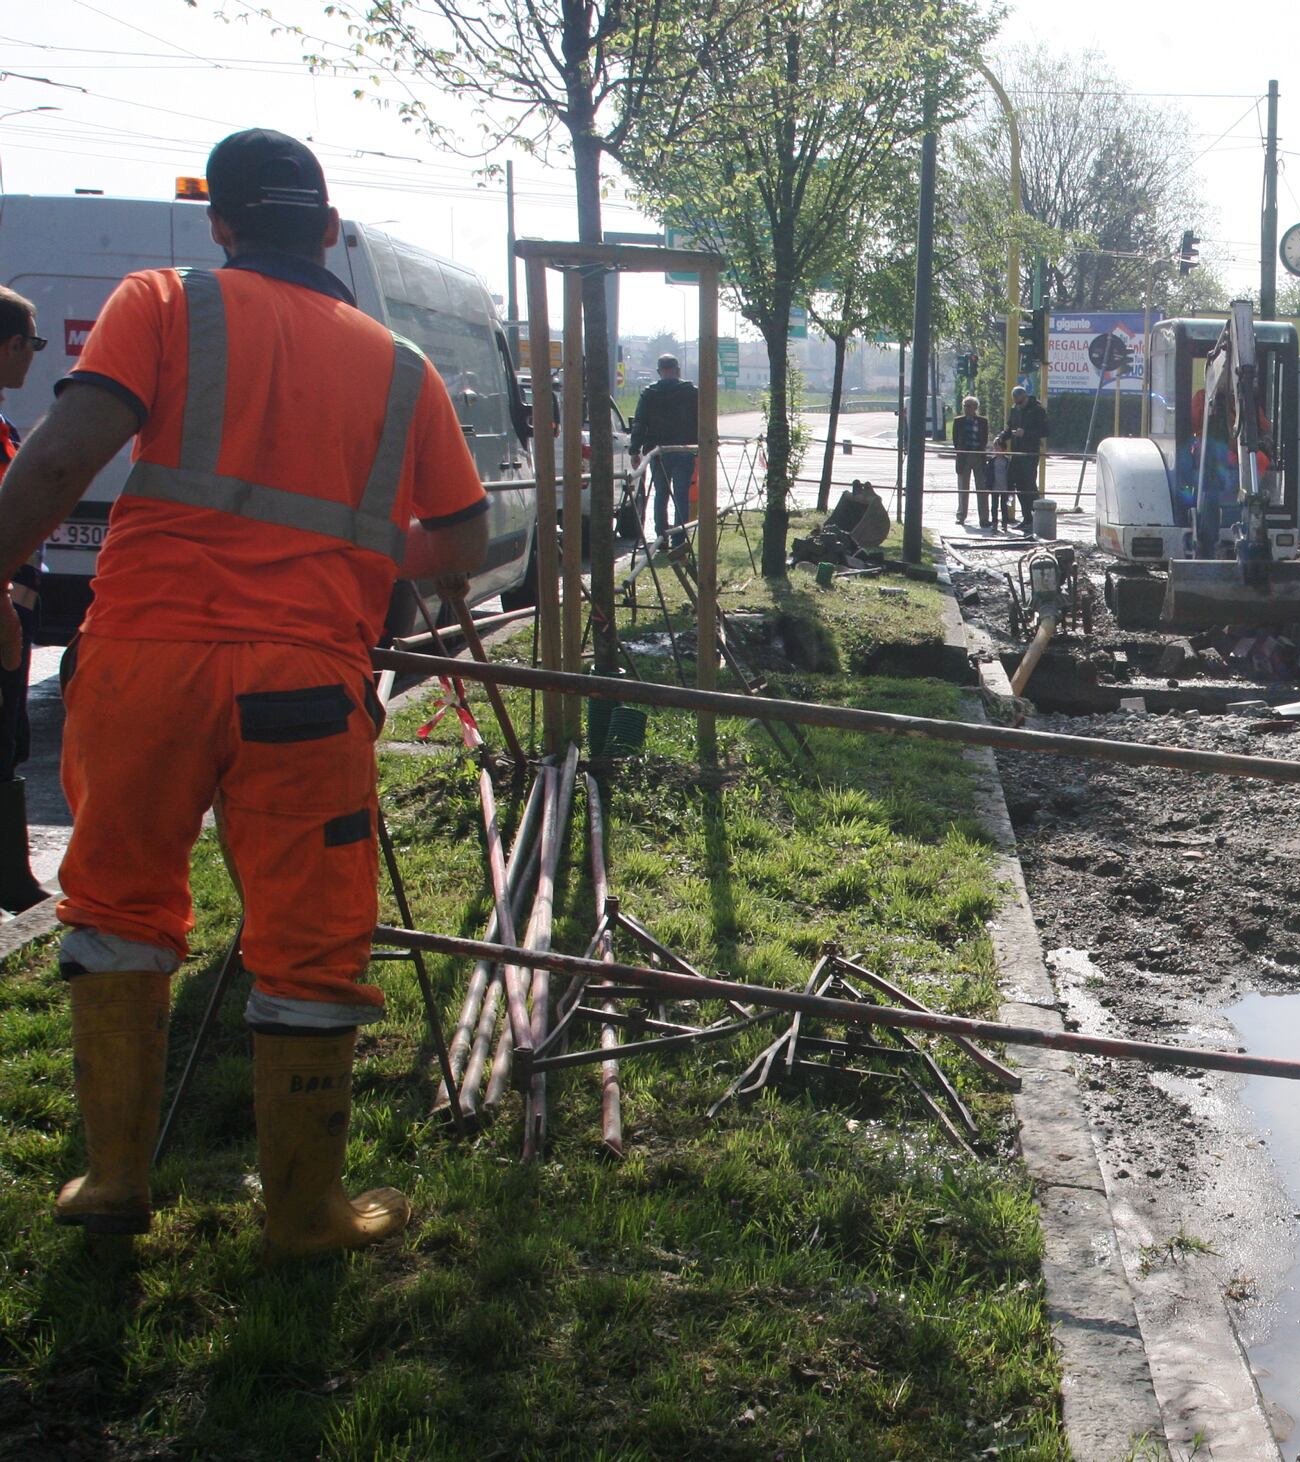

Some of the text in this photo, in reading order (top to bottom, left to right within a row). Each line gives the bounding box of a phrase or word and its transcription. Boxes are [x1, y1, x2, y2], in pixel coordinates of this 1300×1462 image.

[1056, 317, 1091, 331] gigante
[1048, 339, 1089, 350] REGALA
[1048, 362, 1090, 372] SCUOLA
